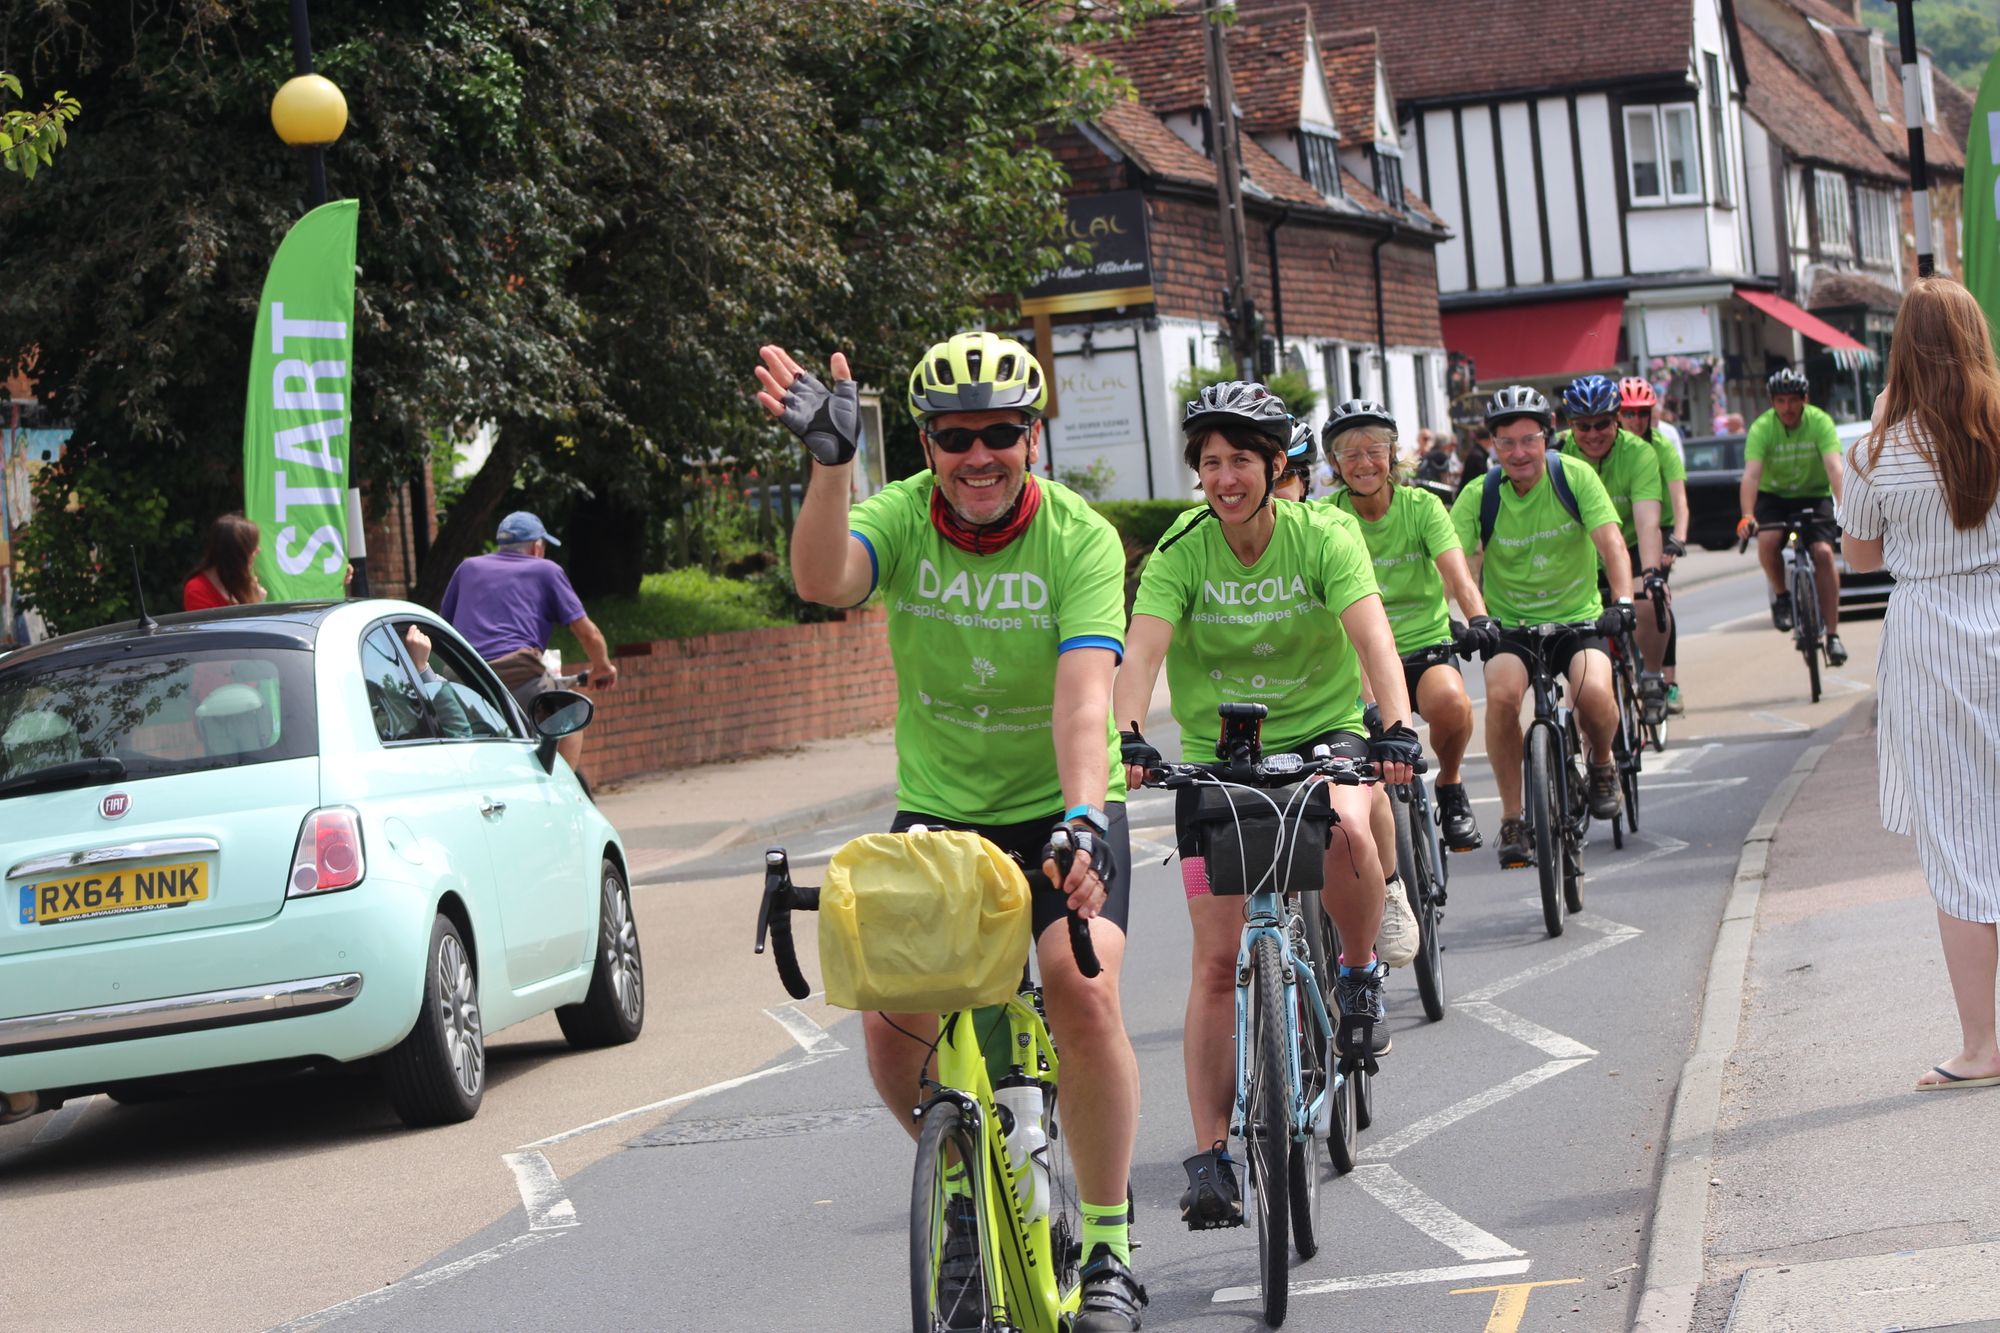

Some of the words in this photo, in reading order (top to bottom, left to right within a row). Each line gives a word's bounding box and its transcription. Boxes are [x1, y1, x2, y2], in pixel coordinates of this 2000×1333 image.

[1095, 258, 1144, 275] Kitchen
[271, 301, 347, 576] START
[917, 558, 1048, 611] DAVID
[1204, 574, 1308, 606] NICOLA
[105, 797, 125, 813] FIAT
[41, 876, 124, 915] RX64
[135, 867, 199, 901] NNK
